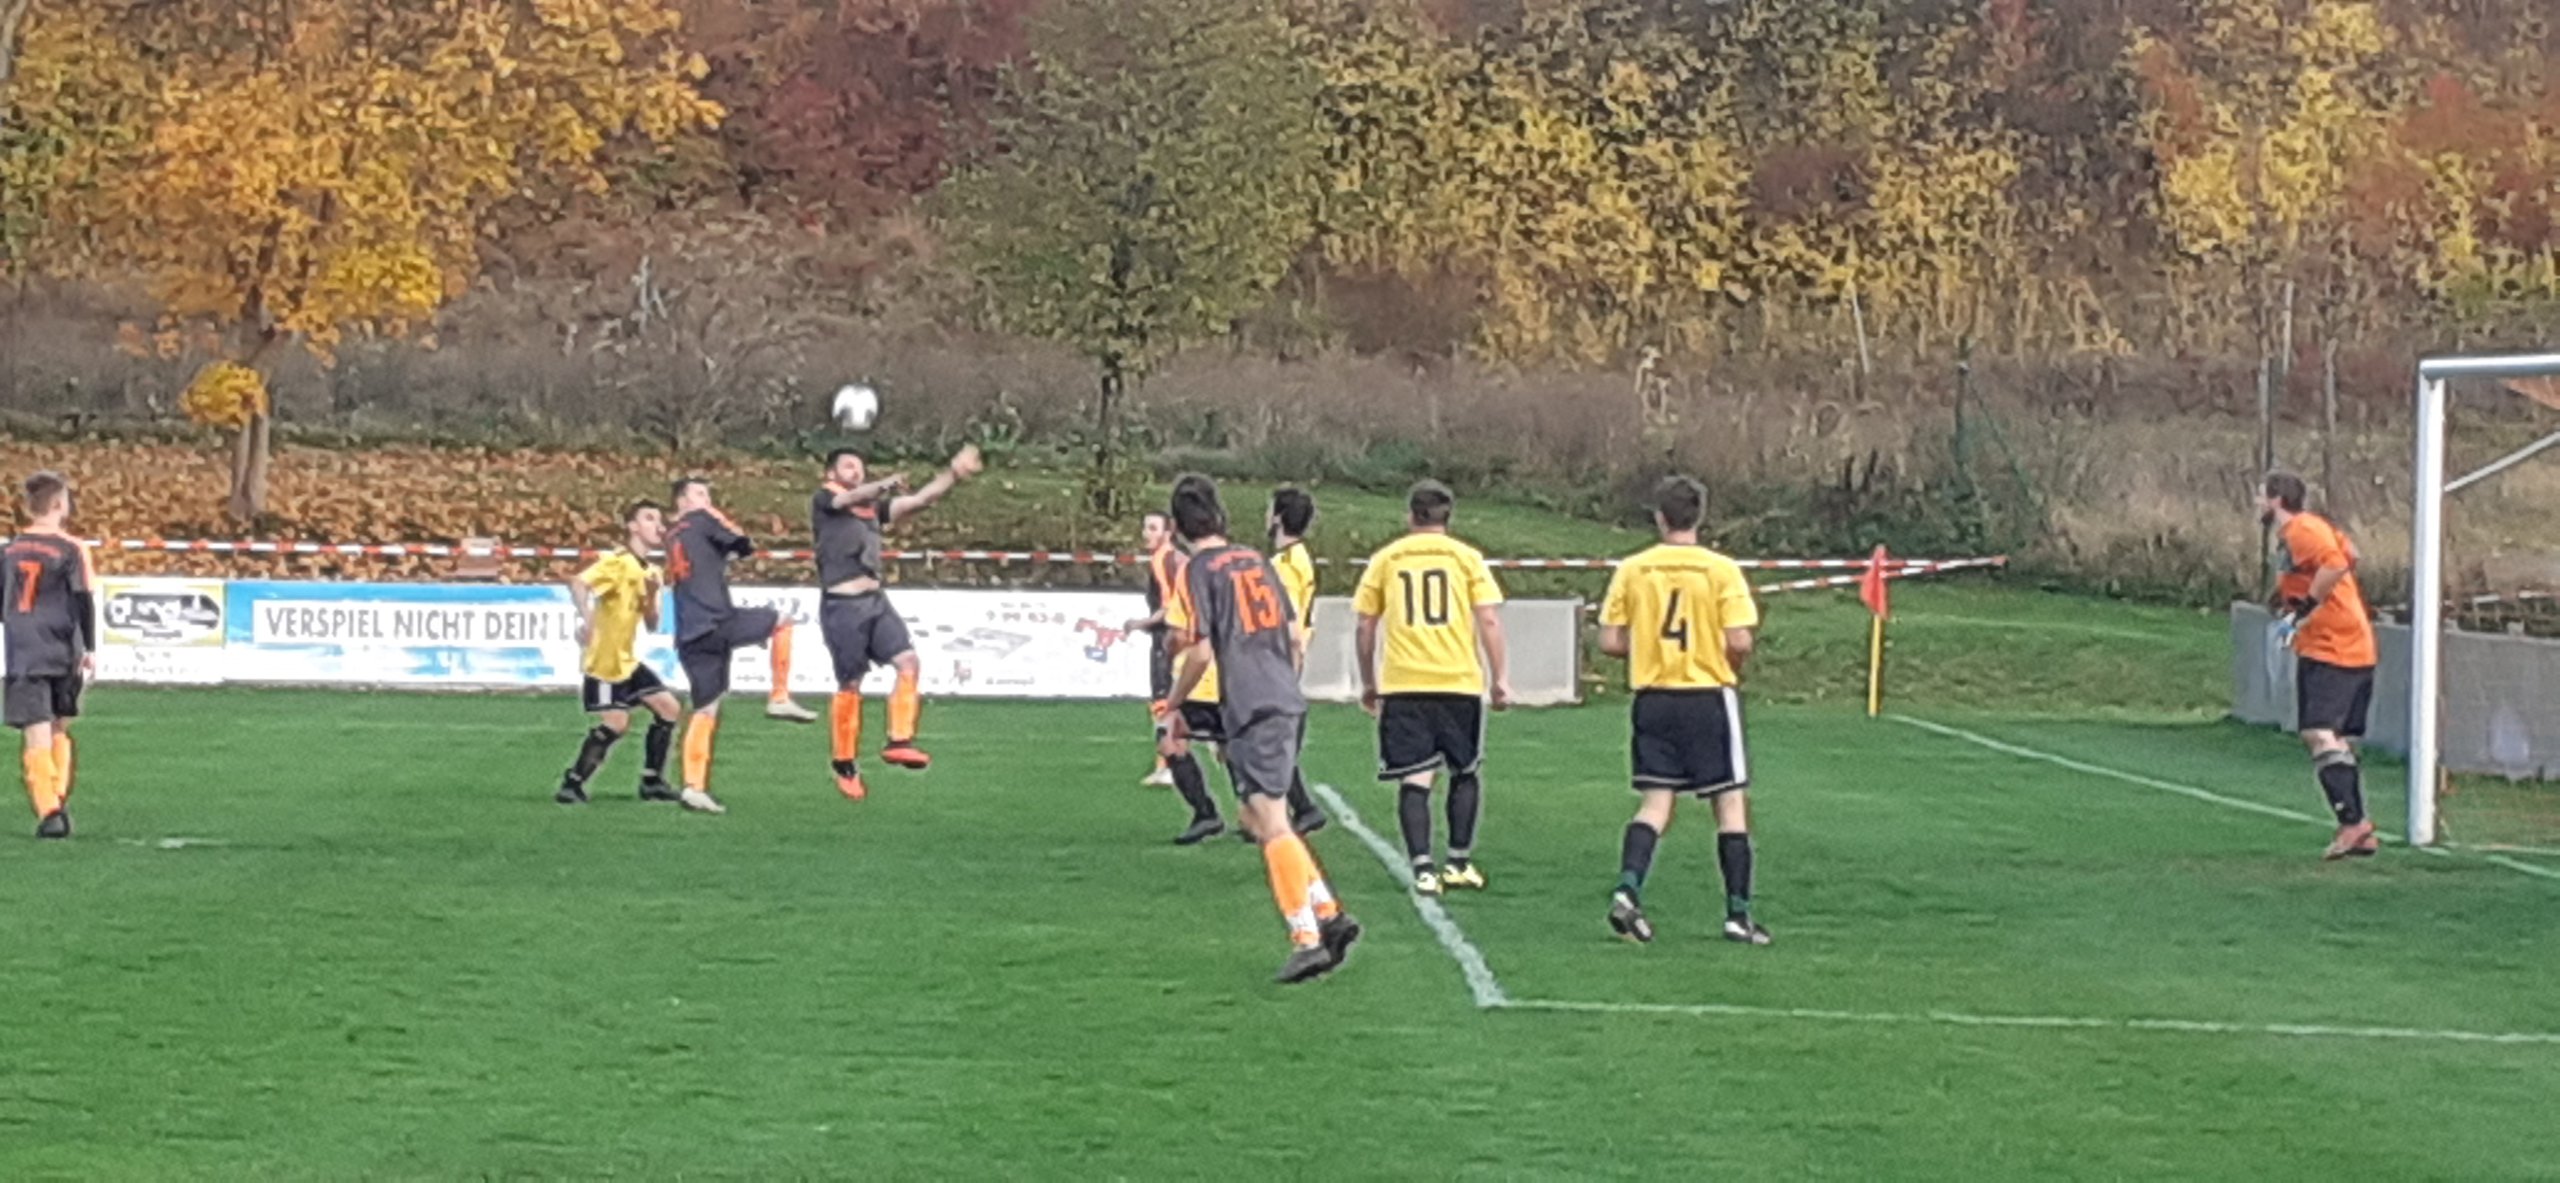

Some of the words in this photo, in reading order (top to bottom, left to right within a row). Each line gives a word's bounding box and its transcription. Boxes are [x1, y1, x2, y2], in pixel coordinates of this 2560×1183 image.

[18, 560, 43, 613] 7
[1230, 566, 1279, 634] 15
[1398, 567, 1448, 627] 10
[266, 606, 384, 638] VERSPIEL
[394, 609, 475, 641] NICHT
[485, 610, 549, 641] DEIN
[1661, 587, 1688, 653] 4
